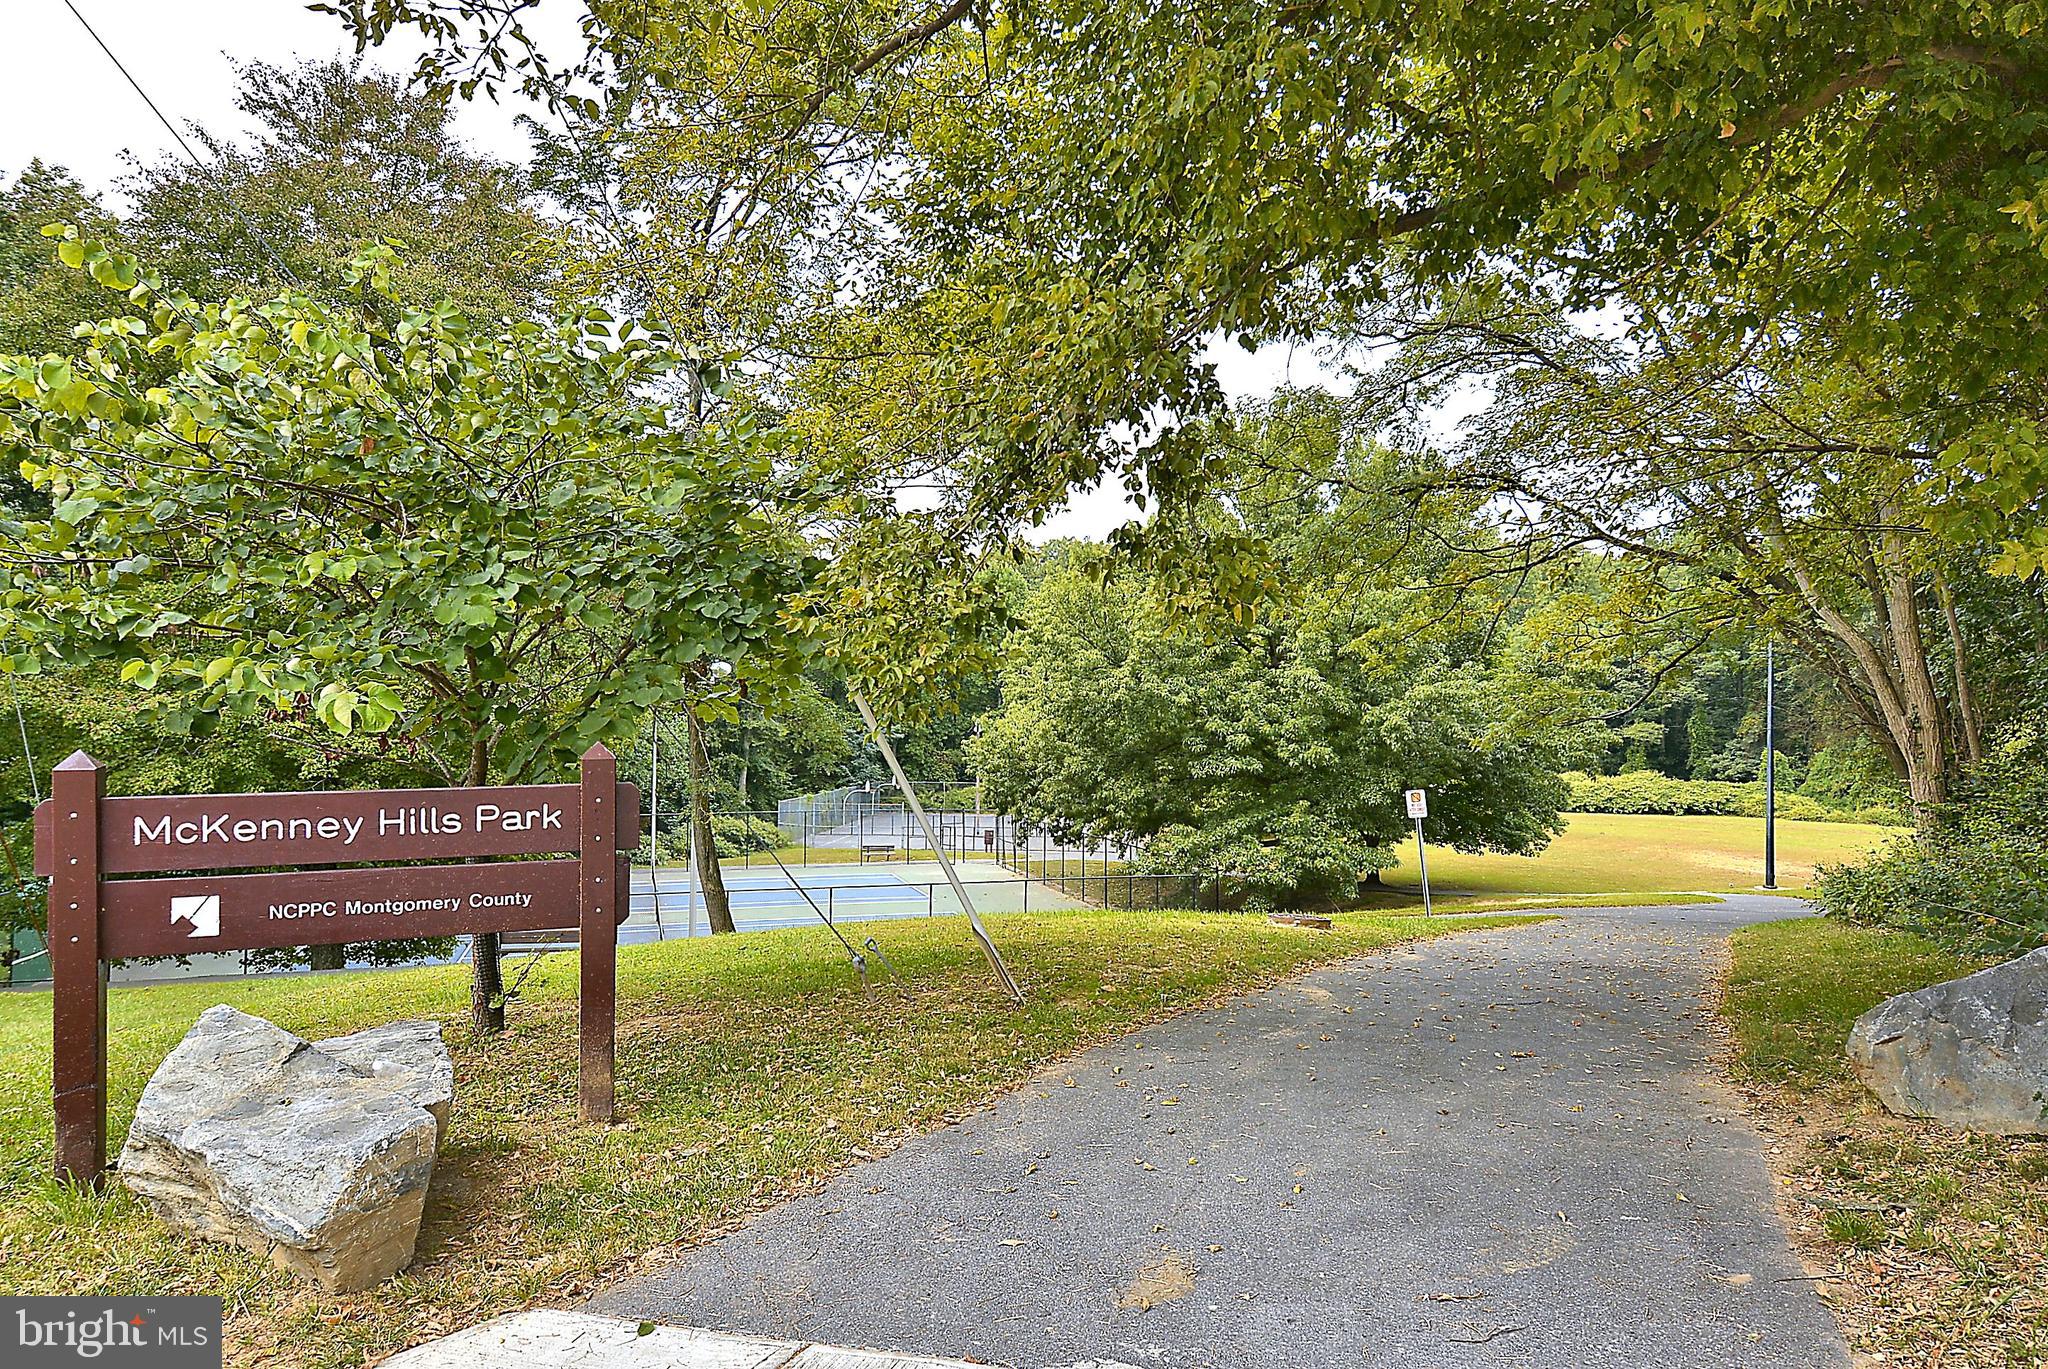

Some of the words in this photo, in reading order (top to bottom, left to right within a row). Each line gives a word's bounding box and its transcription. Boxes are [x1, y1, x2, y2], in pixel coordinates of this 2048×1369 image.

[133, 814, 364, 846] McKenney
[379, 807, 462, 836] Hills
[475, 803, 563, 832] Park
[269, 901, 337, 920] NCPPC
[345, 896, 461, 916] Montgomery
[469, 892, 532, 909] County
